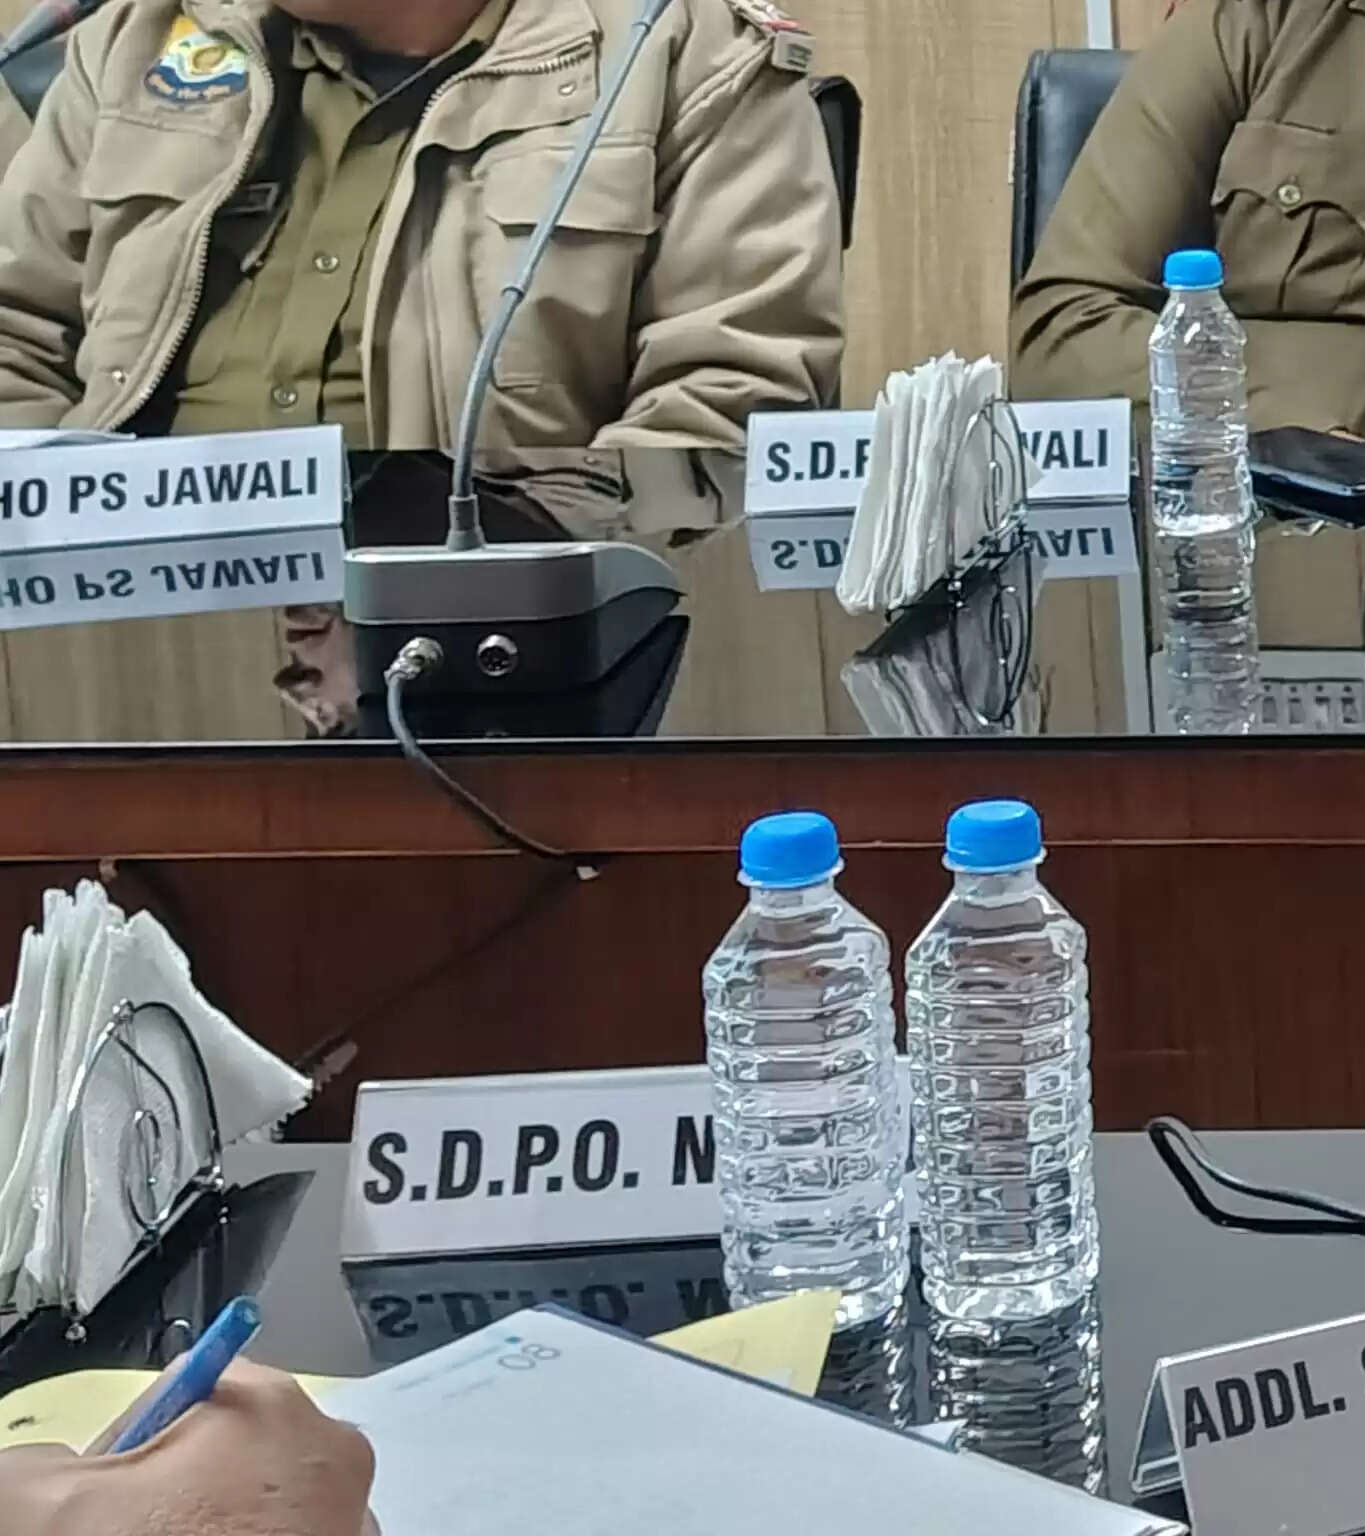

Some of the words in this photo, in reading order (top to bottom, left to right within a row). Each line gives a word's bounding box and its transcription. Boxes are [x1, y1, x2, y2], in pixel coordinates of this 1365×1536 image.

[69, 472, 128, 514] PS
[144, 457, 318, 508] JAWALI
[363, 1119, 640, 1205] S.D.P.O.
[1184, 1361, 1346, 1448] ADDL.
